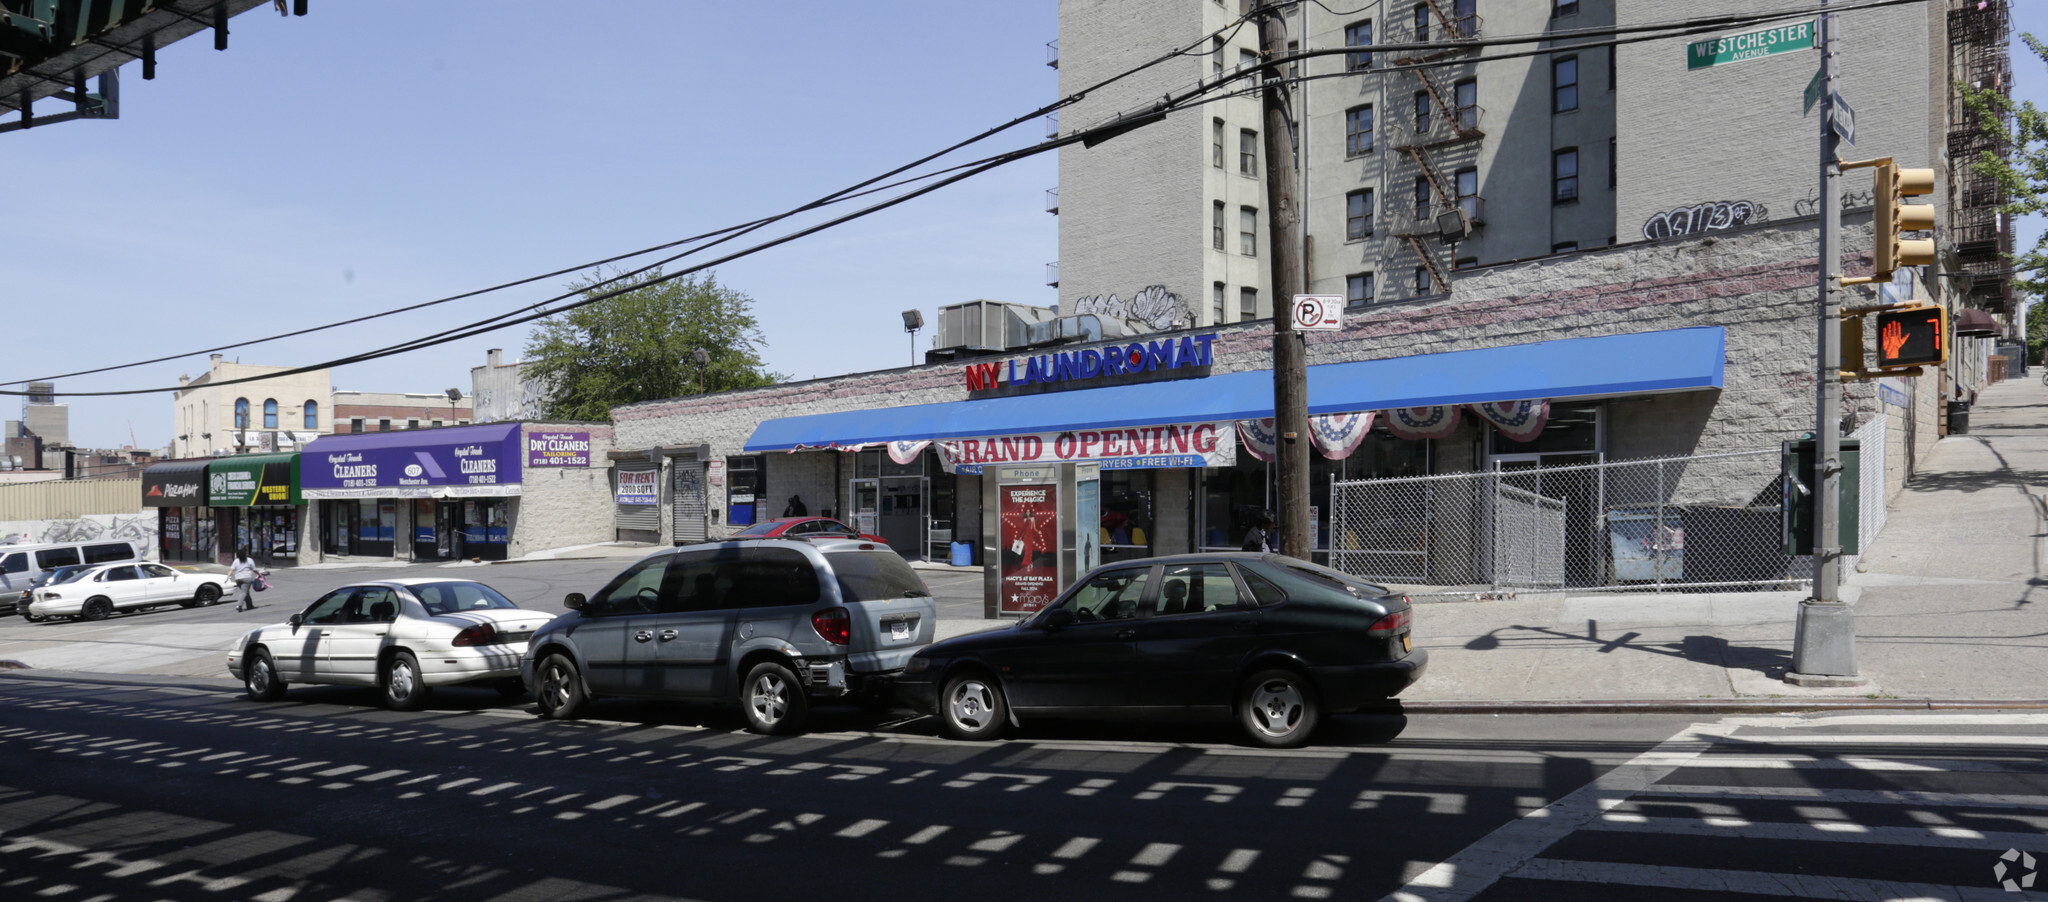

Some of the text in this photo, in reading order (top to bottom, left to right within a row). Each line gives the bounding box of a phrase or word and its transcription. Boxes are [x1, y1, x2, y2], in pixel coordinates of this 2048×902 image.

[1695, 24, 1808, 58] WESTCHESTER
[1732, 46, 1770, 61] AVENUE
[1926, 318, 1940, 350] 7
[966, 333, 1219, 392] NY LAUNDROMAT
[530, 439, 589, 451] DRY CLEANERS
[944, 423, 1219, 465] GRAND OPENING
[460, 458, 497, 474] CLEANERS
[549, 456, 587, 464] 401-1522
[1142, 457, 1166, 466] FREE
[1168, 456, 1193, 466] WI-FI
[334, 464, 377, 478] CLEANERS
[407, 466, 420, 475] 607
[619, 471, 655, 484] FOR RENT
[164, 483, 199, 498] Pizza Hut
[262, 485, 287, 493] WESTERN
